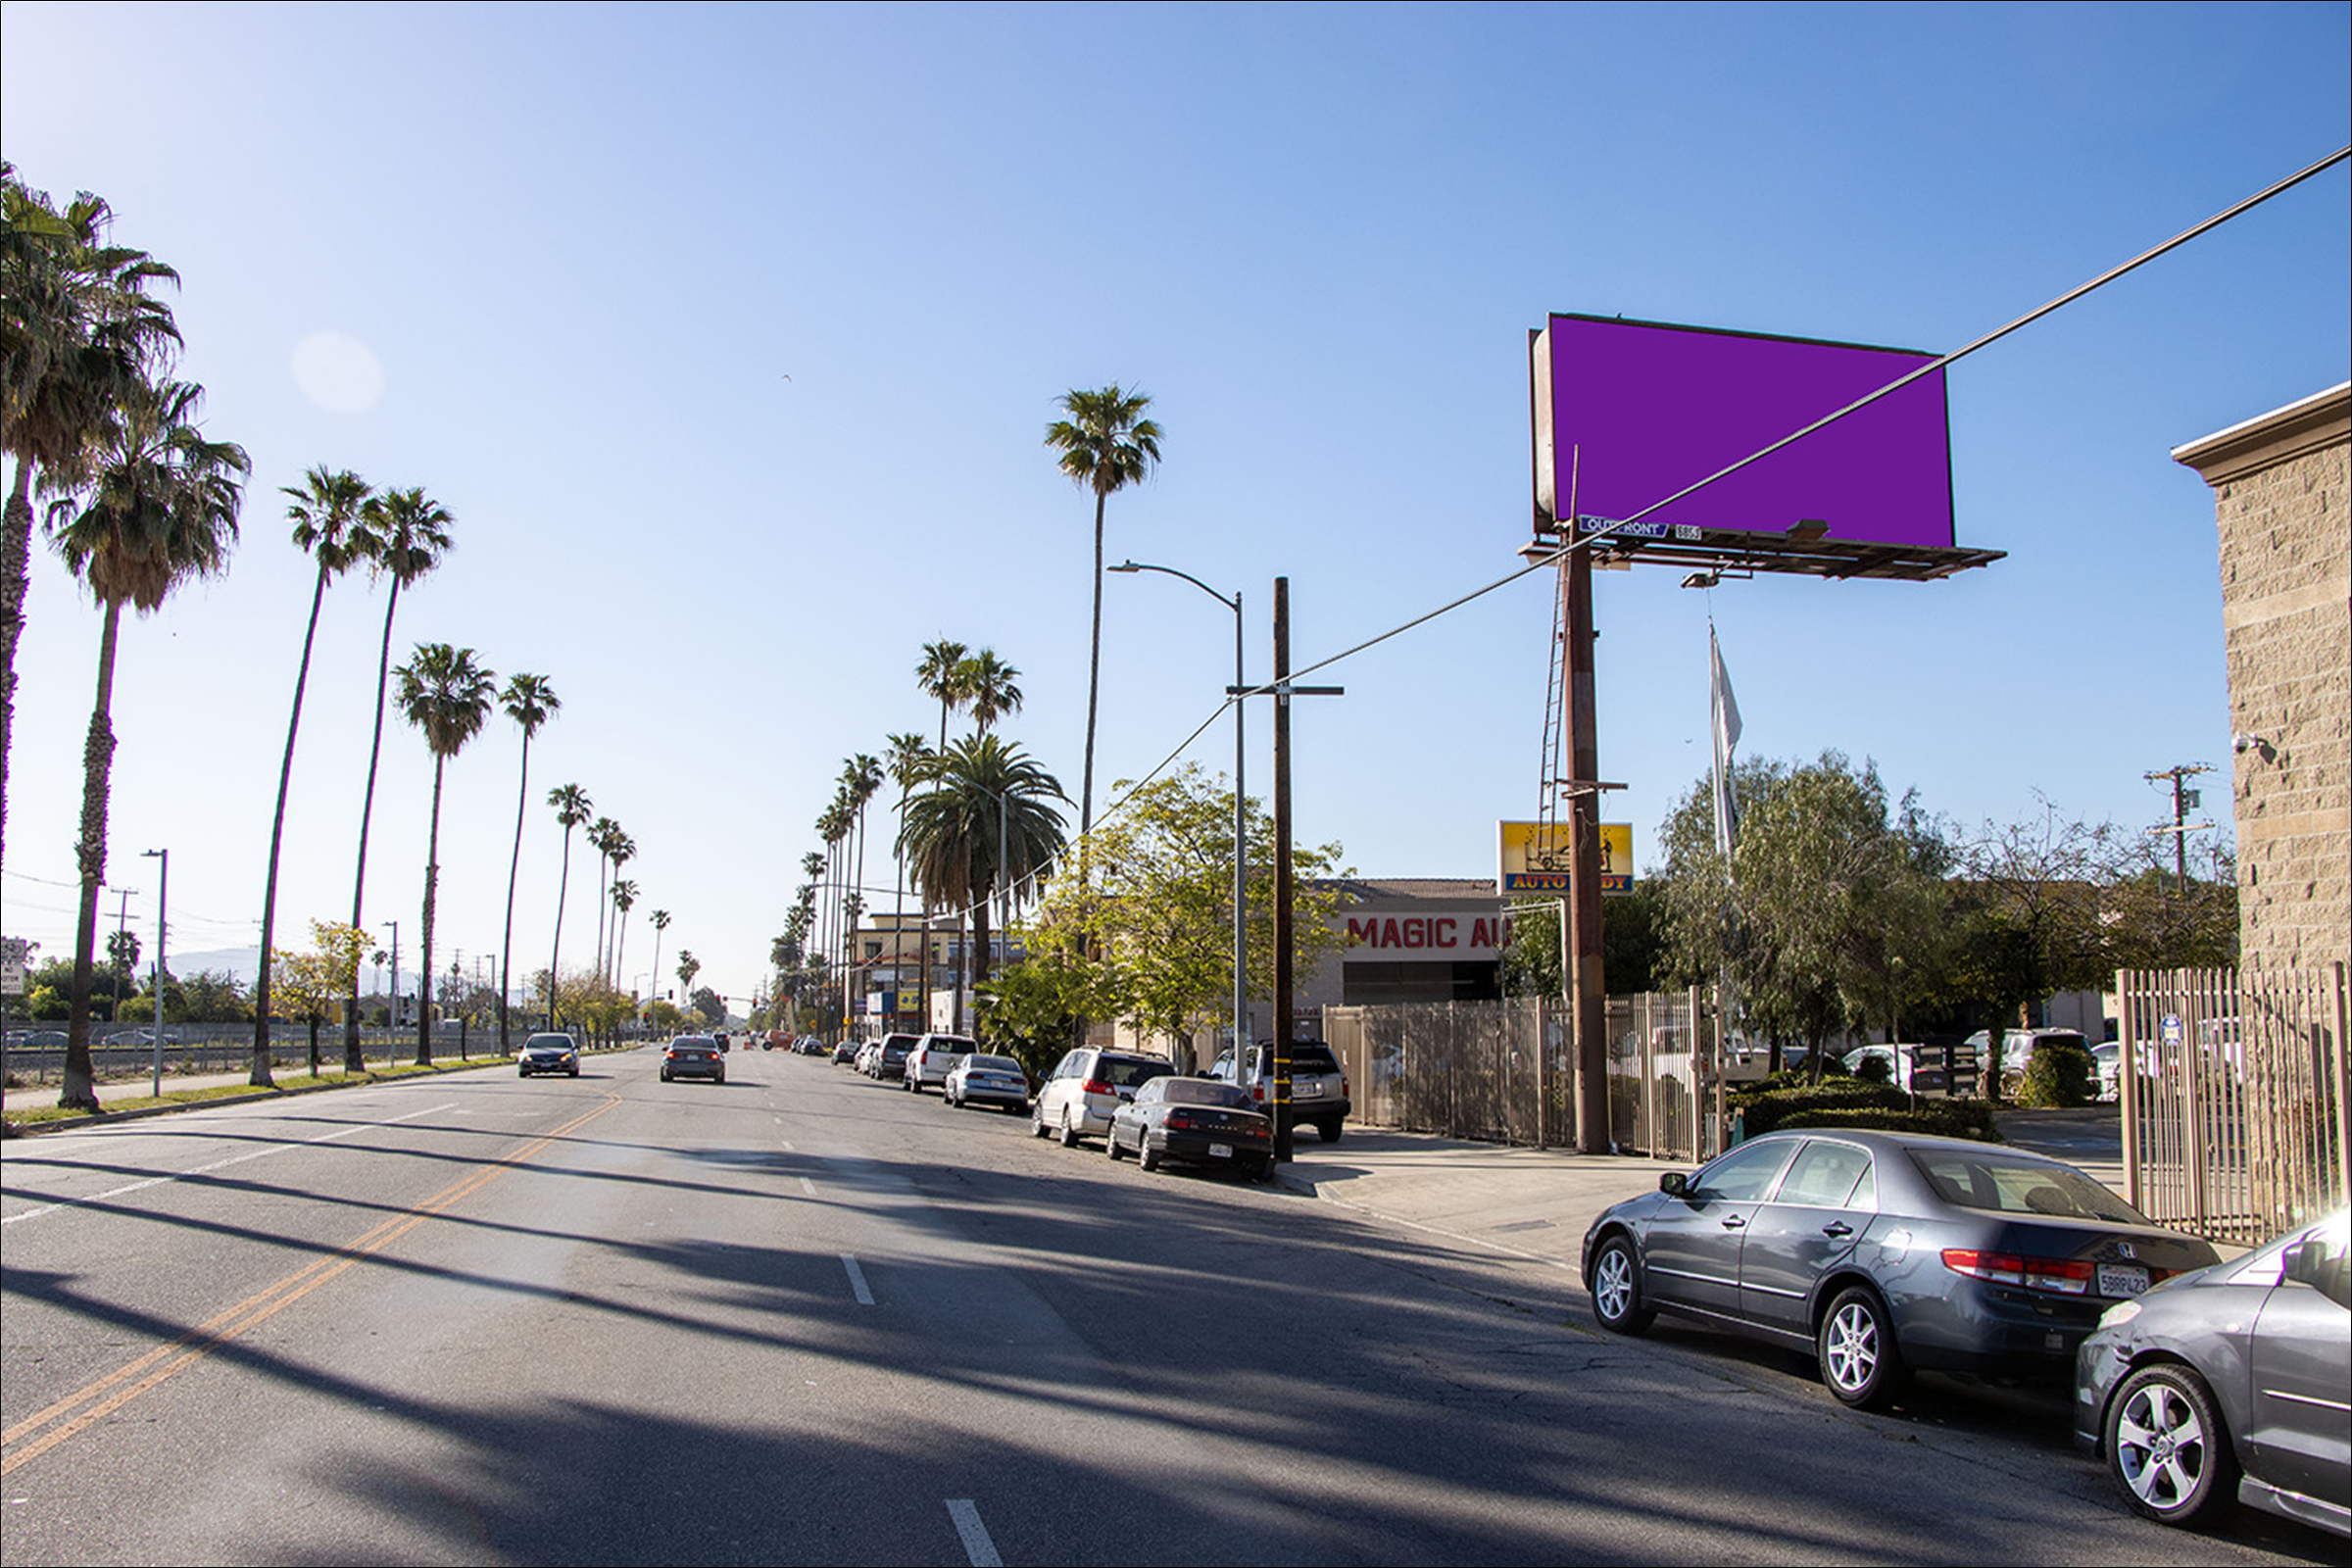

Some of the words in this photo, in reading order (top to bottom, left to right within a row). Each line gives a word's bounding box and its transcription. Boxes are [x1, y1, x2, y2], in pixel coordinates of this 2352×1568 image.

[1588, 517, 1659, 535] OUTRONT
[1512, 875, 1567, 889] AUTO
[1601, 876, 1627, 890] DY
[1348, 917, 1457, 949] MAGIC
[1471, 917, 1512, 949] AU
